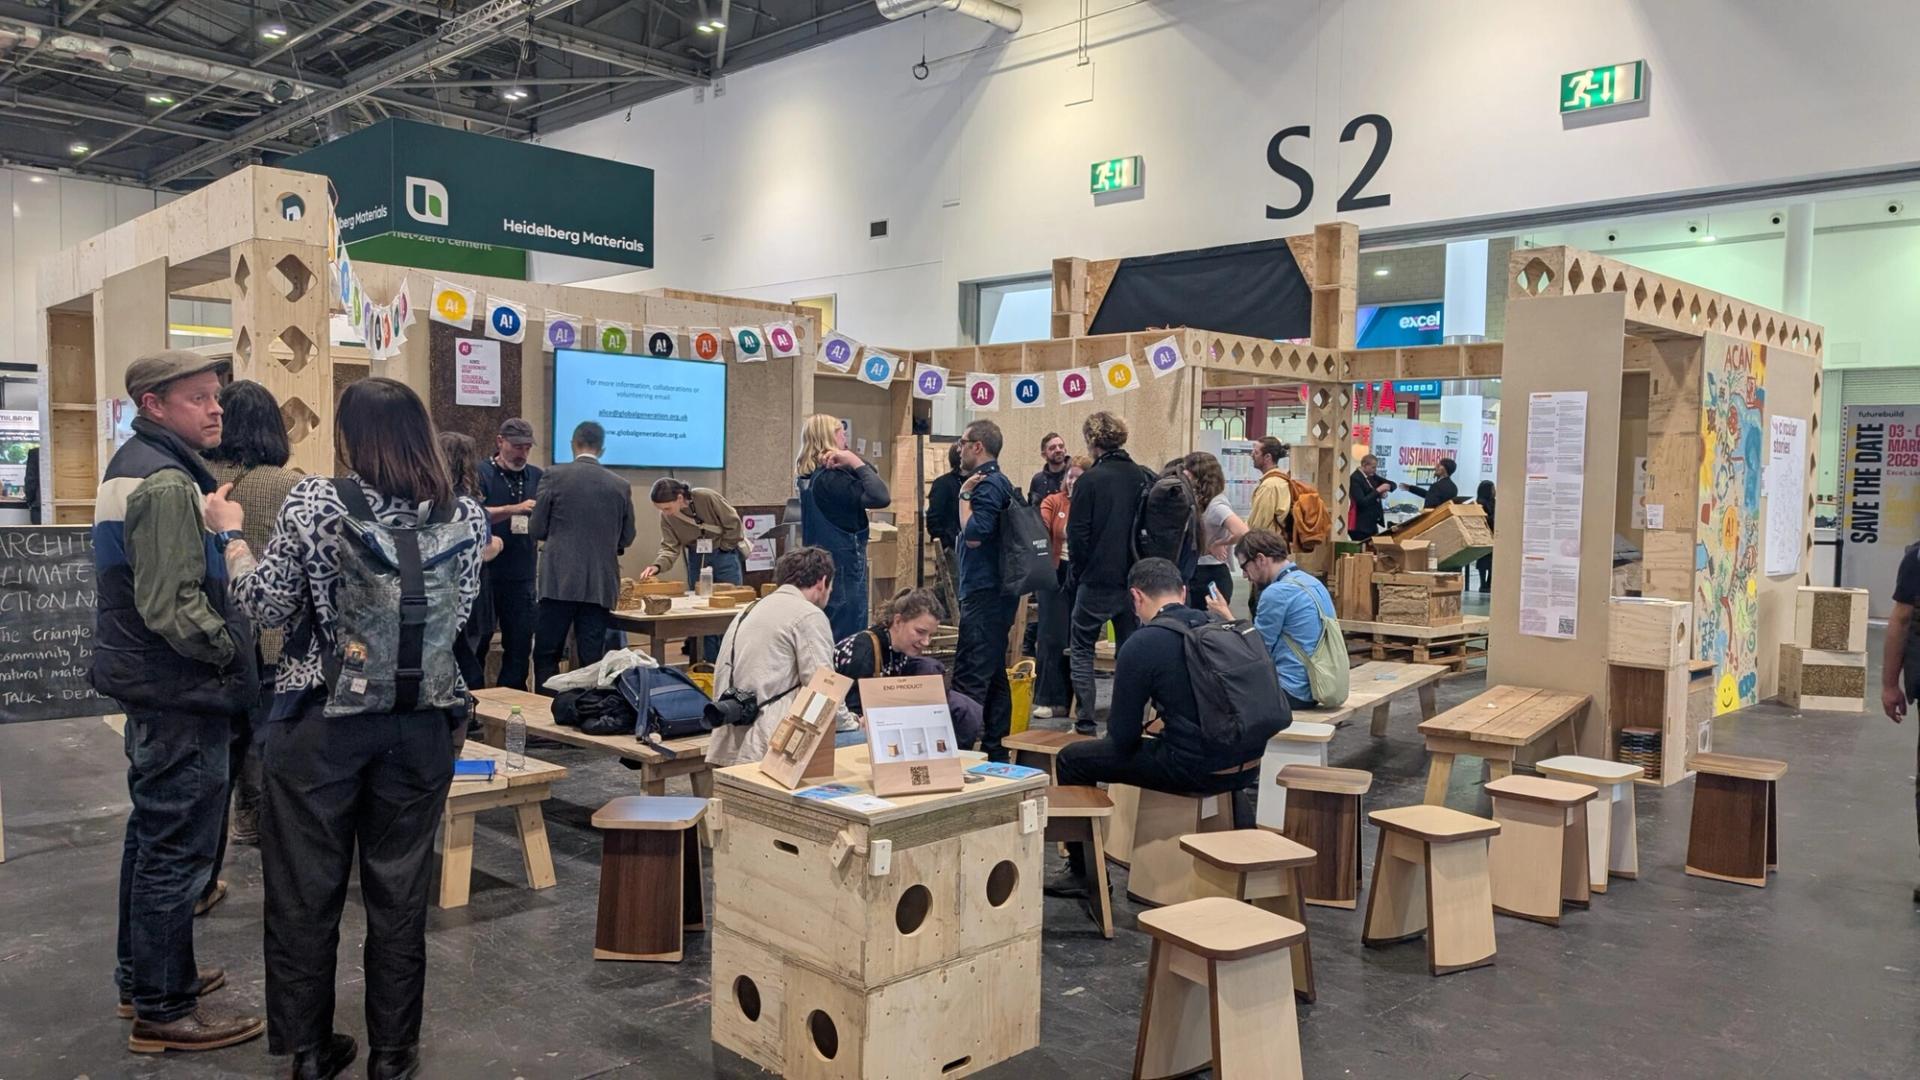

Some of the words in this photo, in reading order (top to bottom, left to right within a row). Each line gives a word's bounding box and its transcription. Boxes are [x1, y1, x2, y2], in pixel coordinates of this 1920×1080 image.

[1266, 125, 1314, 220] S
[1336, 113, 1393, 213] 2
[355, 204, 388, 226] Materials
[503, 218, 581, 245] Heidelberg
[583, 231, 645, 253] Materials
[445, 299, 459, 313] A!
[500, 314, 513, 329] A!
[1399, 310, 1441, 329] excel
[555, 328, 568, 343] A!
[608, 336, 621, 349] A!
[743, 335, 755, 348] A!
[777, 334, 788, 346] A!
[655, 340, 668, 353] A!
[701, 340, 712, 353] A!
[831, 345, 844, 358] A!
[1159, 351, 1172, 365] A!
[1724, 344, 1753, 373] ACAN
[870, 363, 883, 377] A!
[1114, 370, 1126, 382] A!
[616, 379, 651, 391] information,
[653, 383, 692, 393] collaborations
[924, 377, 937, 389] A!
[1069, 379, 1080, 393] A!
[616, 391, 653, 400] volunteering
[976, 388, 988, 400] A!
[1022, 385, 1034, 397] A!
[1858, 410, 1905, 418] futurebuild
[1889, 423, 1905, 438] 03
[1482, 432, 1494, 457] 20
[1855, 423, 1884, 463] DATE
[1887, 453, 1919, 467] 2026
[1853, 468, 1881, 497] THE
[1850, 502, 1879, 544] SAVE
[0, 562, 93, 586] LIMATE
[0, 590, 67, 616] CTION
[32, 624, 92, 647] triangle
[51, 665, 89, 678] mate
[2, 691, 43, 706] TALK
